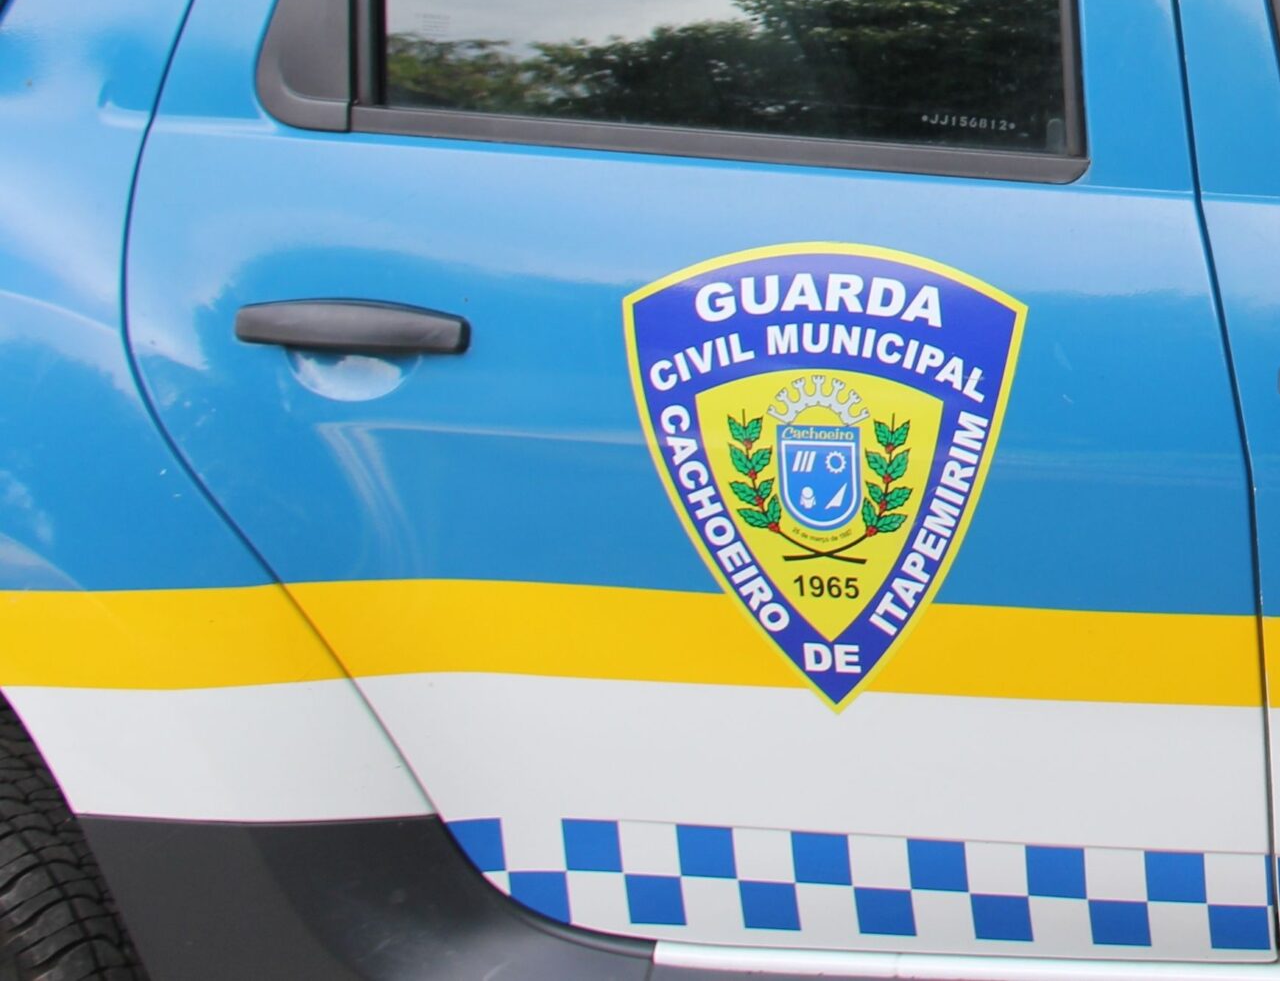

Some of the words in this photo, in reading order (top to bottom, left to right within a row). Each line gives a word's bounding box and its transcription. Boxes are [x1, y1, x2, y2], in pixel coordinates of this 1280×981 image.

[695, 273, 942, 329] GUARDA
[650, 333, 755, 392] CIVIL
[766, 323, 986, 404] MUNICIPAL
[781, 425, 855, 442] Cachoeiro
[660, 404, 791, 633] CACHOEIRO
[803, 642, 862, 674] DE
[869, 411, 989, 637] ITAPEMIRIM
[793, 575, 860, 600] 1965
